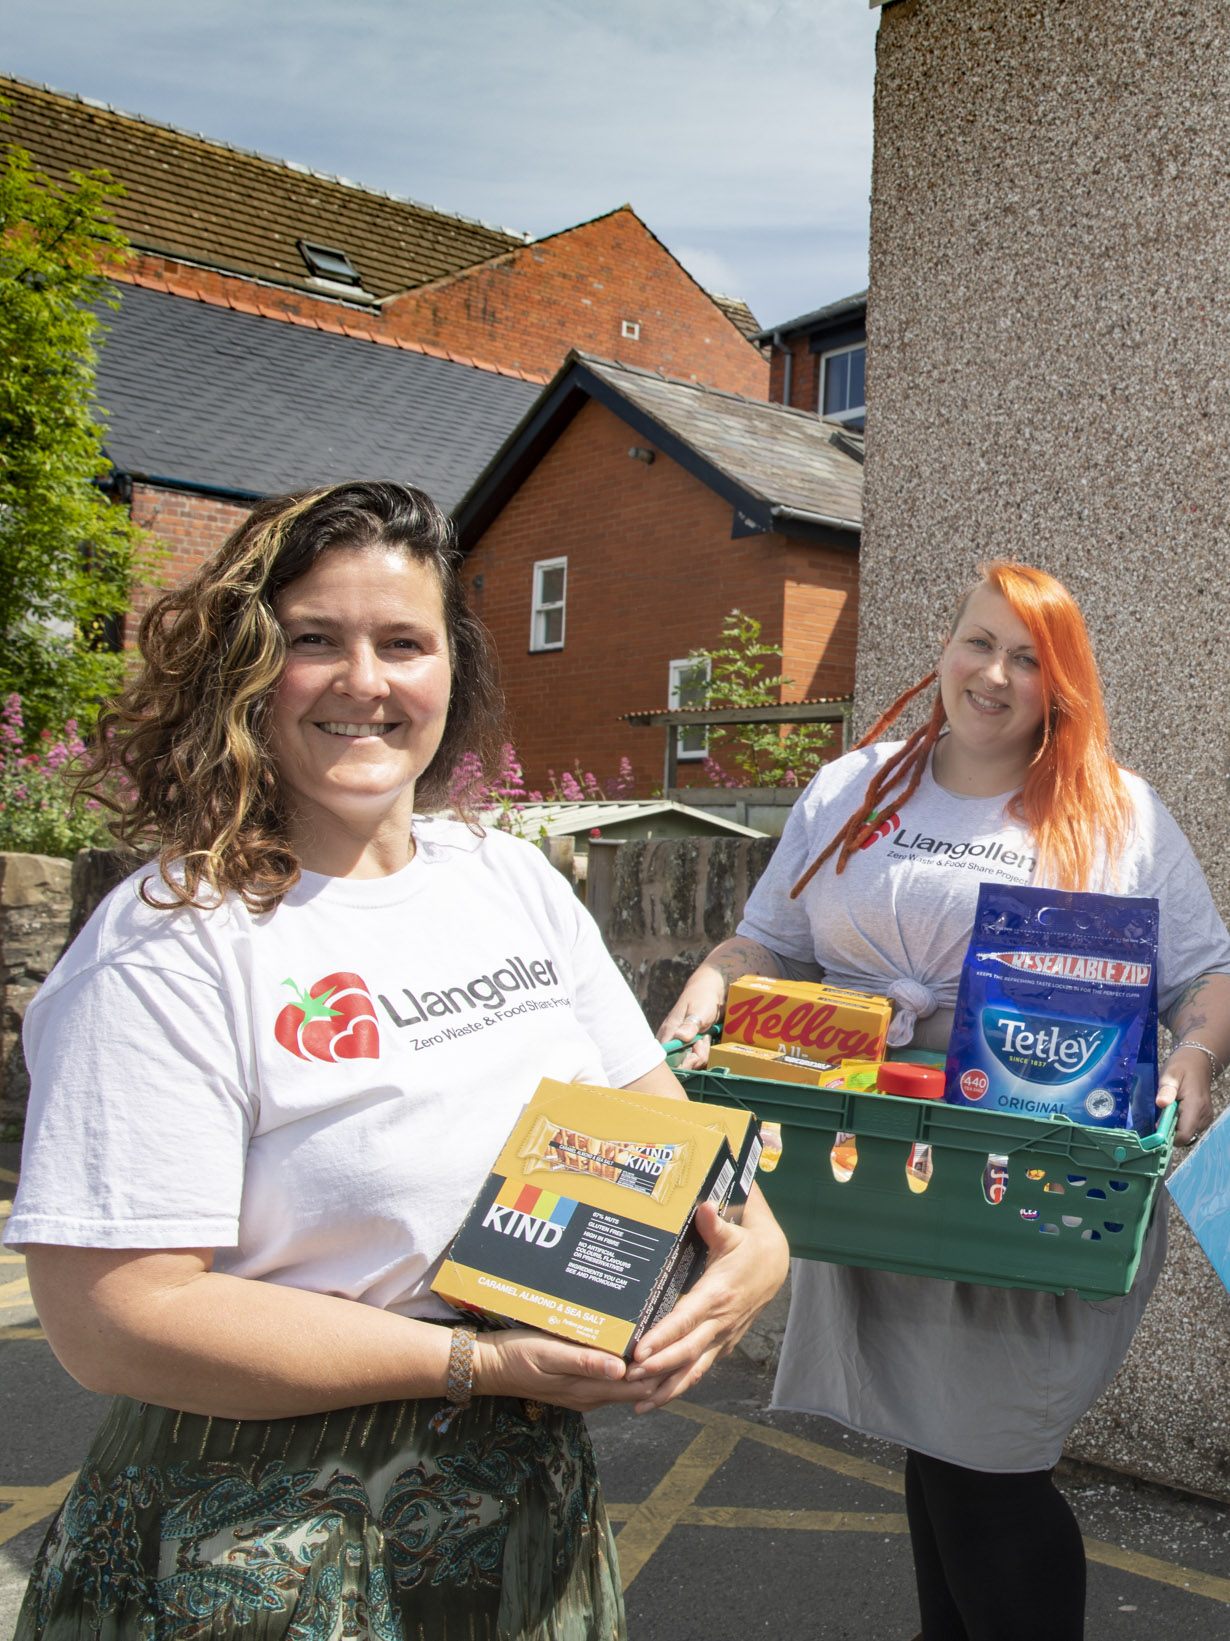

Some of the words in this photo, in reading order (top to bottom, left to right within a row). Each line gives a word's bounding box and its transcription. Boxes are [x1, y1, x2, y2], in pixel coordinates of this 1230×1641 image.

[893, 829, 1037, 873] Llangollen
[886, 850, 906, 860] Zero
[936, 859, 943, 867] &
[944, 860, 966, 868] Food
[967, 862, 995, 875] Share
[996, 868, 1029, 886] Project
[1011, 953, 1118, 982] RESEALABLE
[1120, 964, 1149, 984] ZIP
[410, 1035, 444, 1051] Zero
[441, 1022, 484, 1040] Waste
[483, 1016, 497, 1026] &
[494, 1002, 528, 1021] Food
[526, 1000, 554, 1011] Share
[998, 1018, 1101, 1074] Tetley
[1008, 1056, 1028, 1066] SINCE
[1030, 1058, 1048, 1068] 1837
[964, 1075, 987, 1089] 440
[998, 1095, 1068, 1116] ORIGINAL
[624, 1154, 664, 1176] KIND
[481, 1202, 565, 1250] KIND
[604, 1215, 620, 1225] NUTS
[583, 1230, 597, 1240] HIGH
[604, 1238, 620, 1248] FIBRE
[588, 1222, 610, 1232] GLUTEN
[610, 1228, 624, 1238] FREE
[573, 1251, 583, 1259] OR
[587, 1244, 616, 1258] ARTIFICIAL
[602, 1254, 632, 1269] FLAVOURS
[565, 1266, 577, 1276] SEE
[576, 1270, 589, 1280] AND
[604, 1272, 616, 1282] YOU
[616, 1278, 628, 1286] CAN
[478, 1276, 518, 1297] CARAMEL
[518, 1290, 557, 1310] ALMOND
[556, 1304, 564, 1312] &
[564, 1305, 582, 1318] SEA
[582, 1311, 606, 1326] SALT
